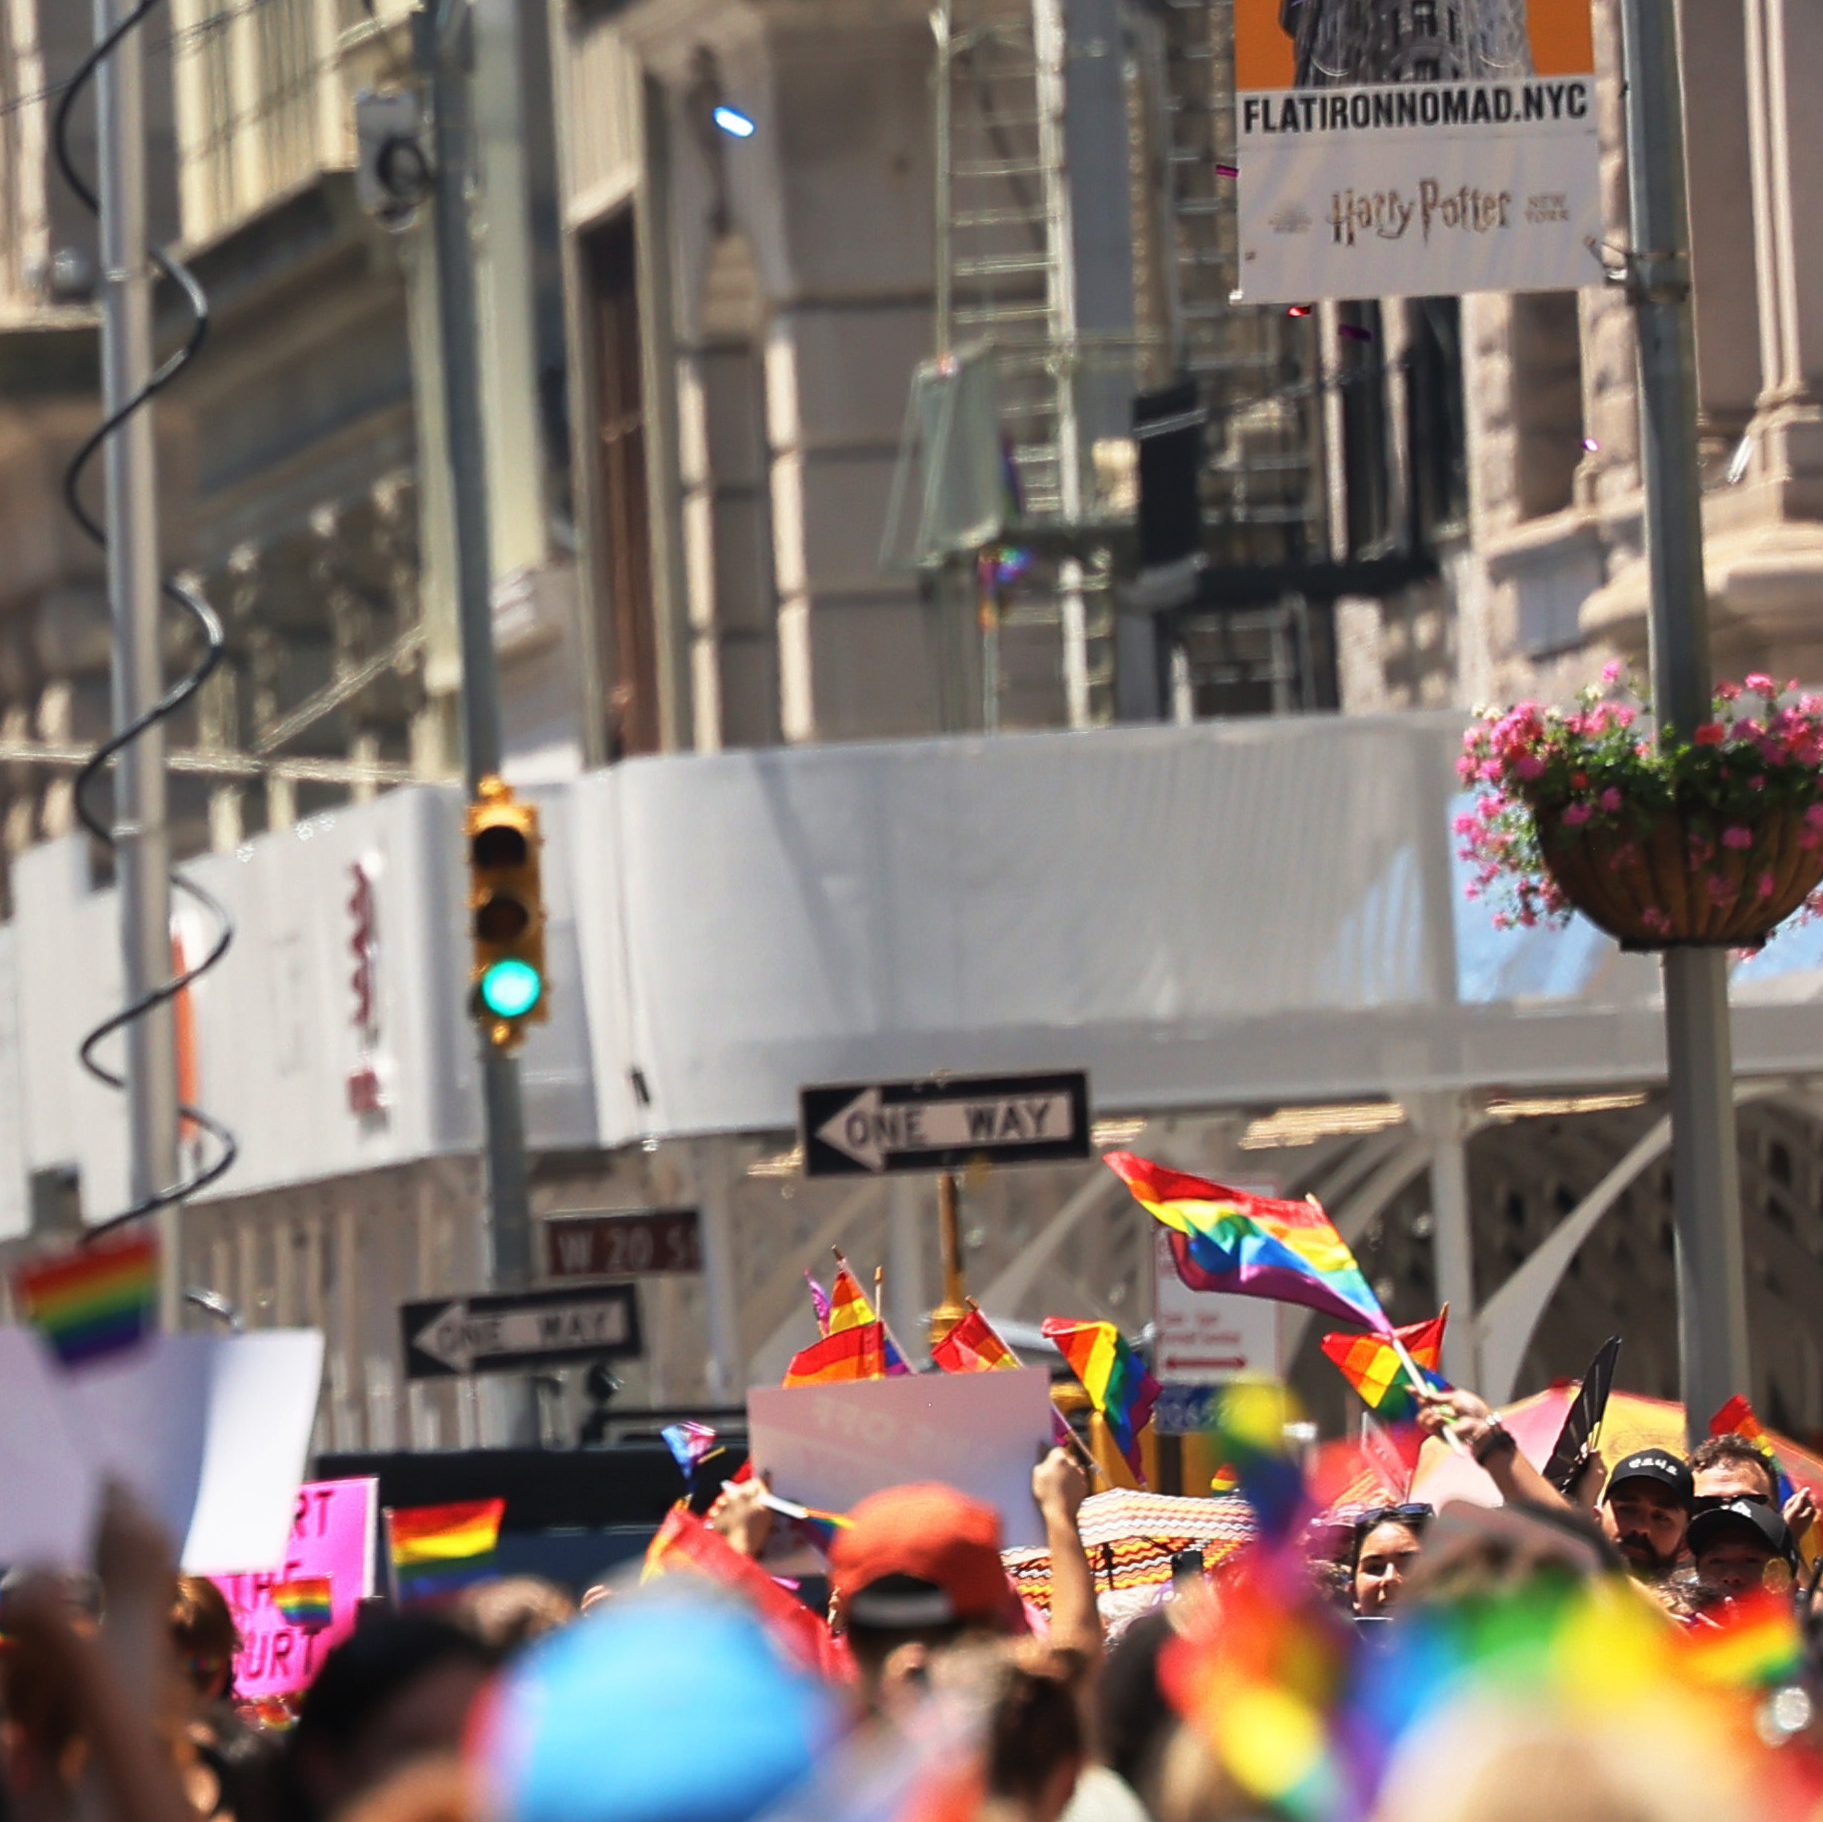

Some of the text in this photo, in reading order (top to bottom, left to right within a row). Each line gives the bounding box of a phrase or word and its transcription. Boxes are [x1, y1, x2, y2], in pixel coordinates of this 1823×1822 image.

[1243, 83, 1589, 135] FLATIRONNOMAD.NYC
[1325, 186, 1416, 248] Harry
[1419, 176, 1512, 247] Potter
[844, 1099, 1052, 1153] ONE WAY
[537, 1309, 607, 1350] WAY
